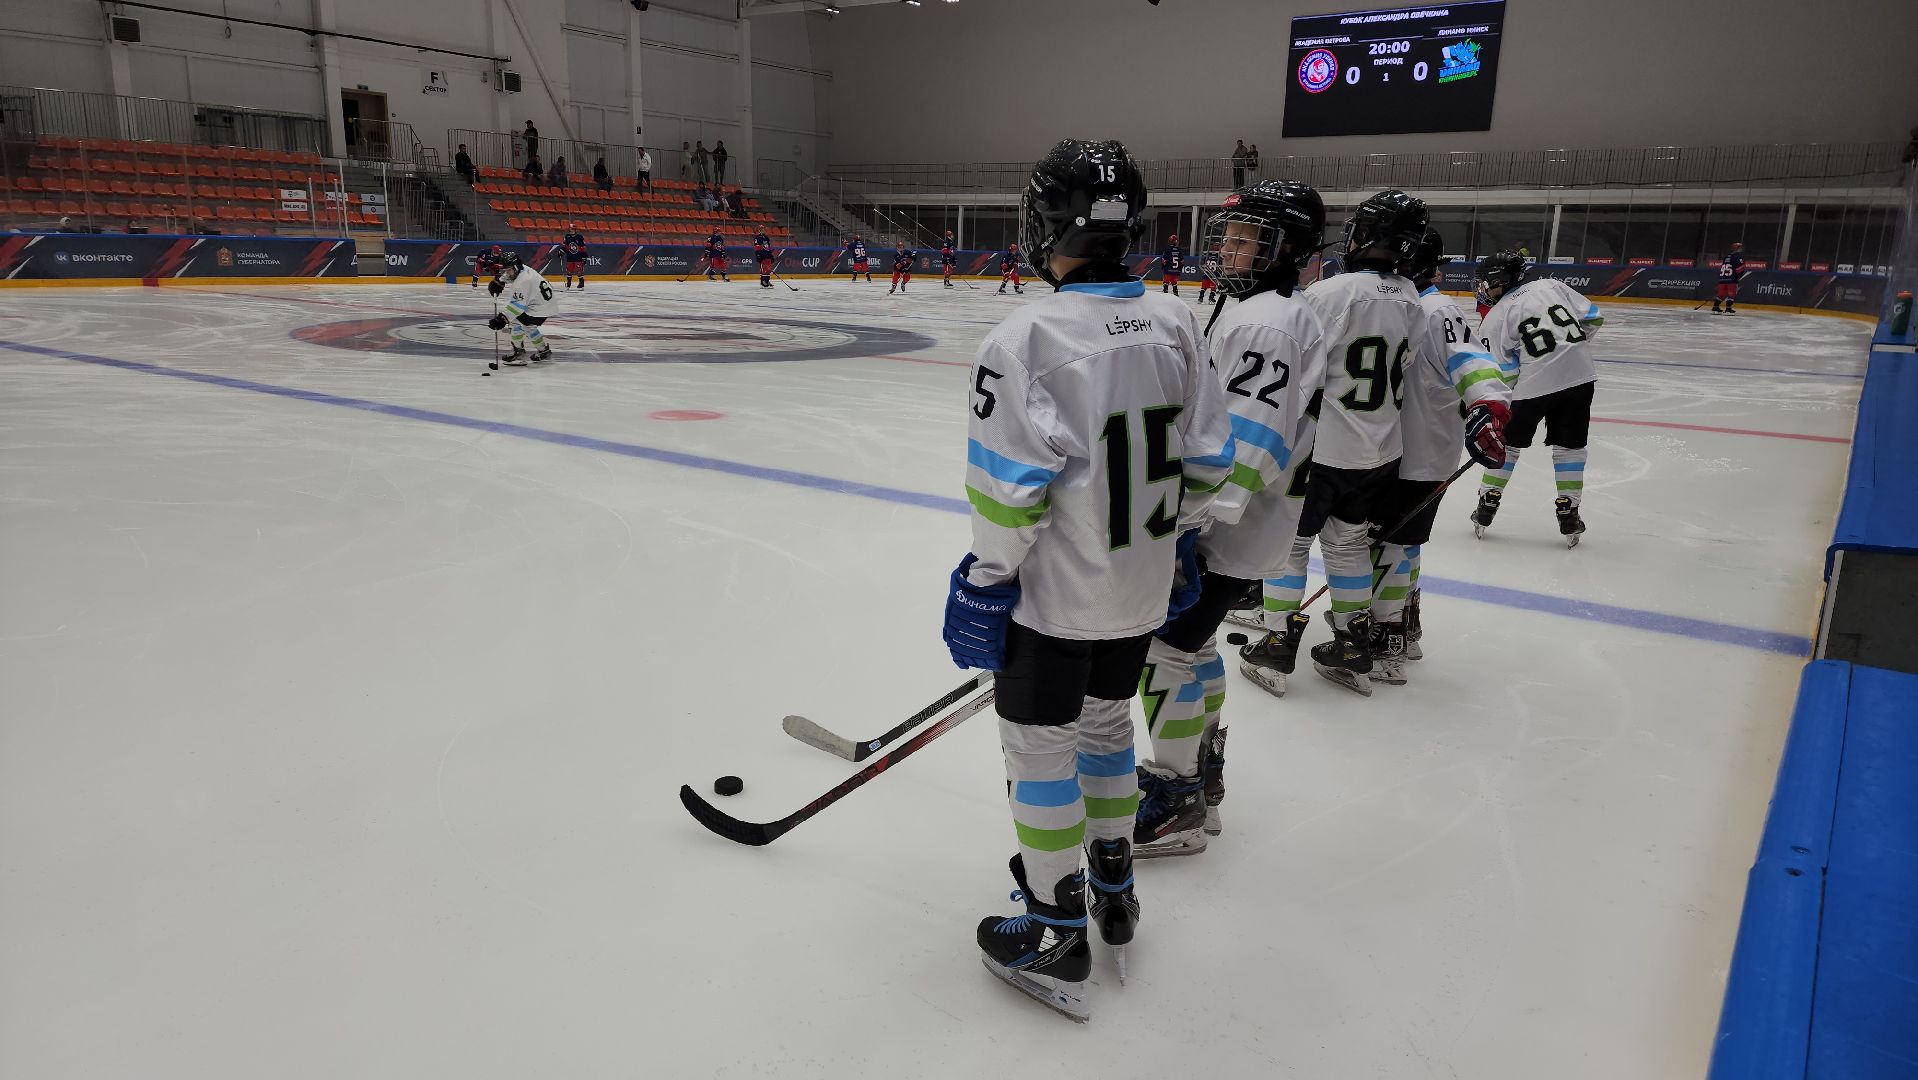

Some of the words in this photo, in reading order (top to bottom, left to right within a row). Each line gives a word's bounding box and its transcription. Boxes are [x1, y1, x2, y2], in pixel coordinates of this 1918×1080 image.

[1368, 40, 1411, 55] 20:00
[1374, 57, 1404, 66] ПЕРИОД
[430, 71, 439, 84] F
[1345, 66, 1361, 85] 0
[1382, 72, 1390, 82] 1
[1413, 61, 1429, 82] 0
[1098, 164, 1116, 183] 15
[854, 248, 866, 258] 96
[801, 257, 821, 268] CUP
[1172, 256, 1179, 269] 5
[1720, 263, 1733, 276] 95
[1756, 283, 1793, 296] Infinix
[1105, 316, 1152, 336] LÉPSHY
[1518, 303, 1587, 358] 69
[1226, 350, 1290, 410] 22
[1098, 404, 1184, 552] 15
[955, 589, 1007, 612] Динамо
